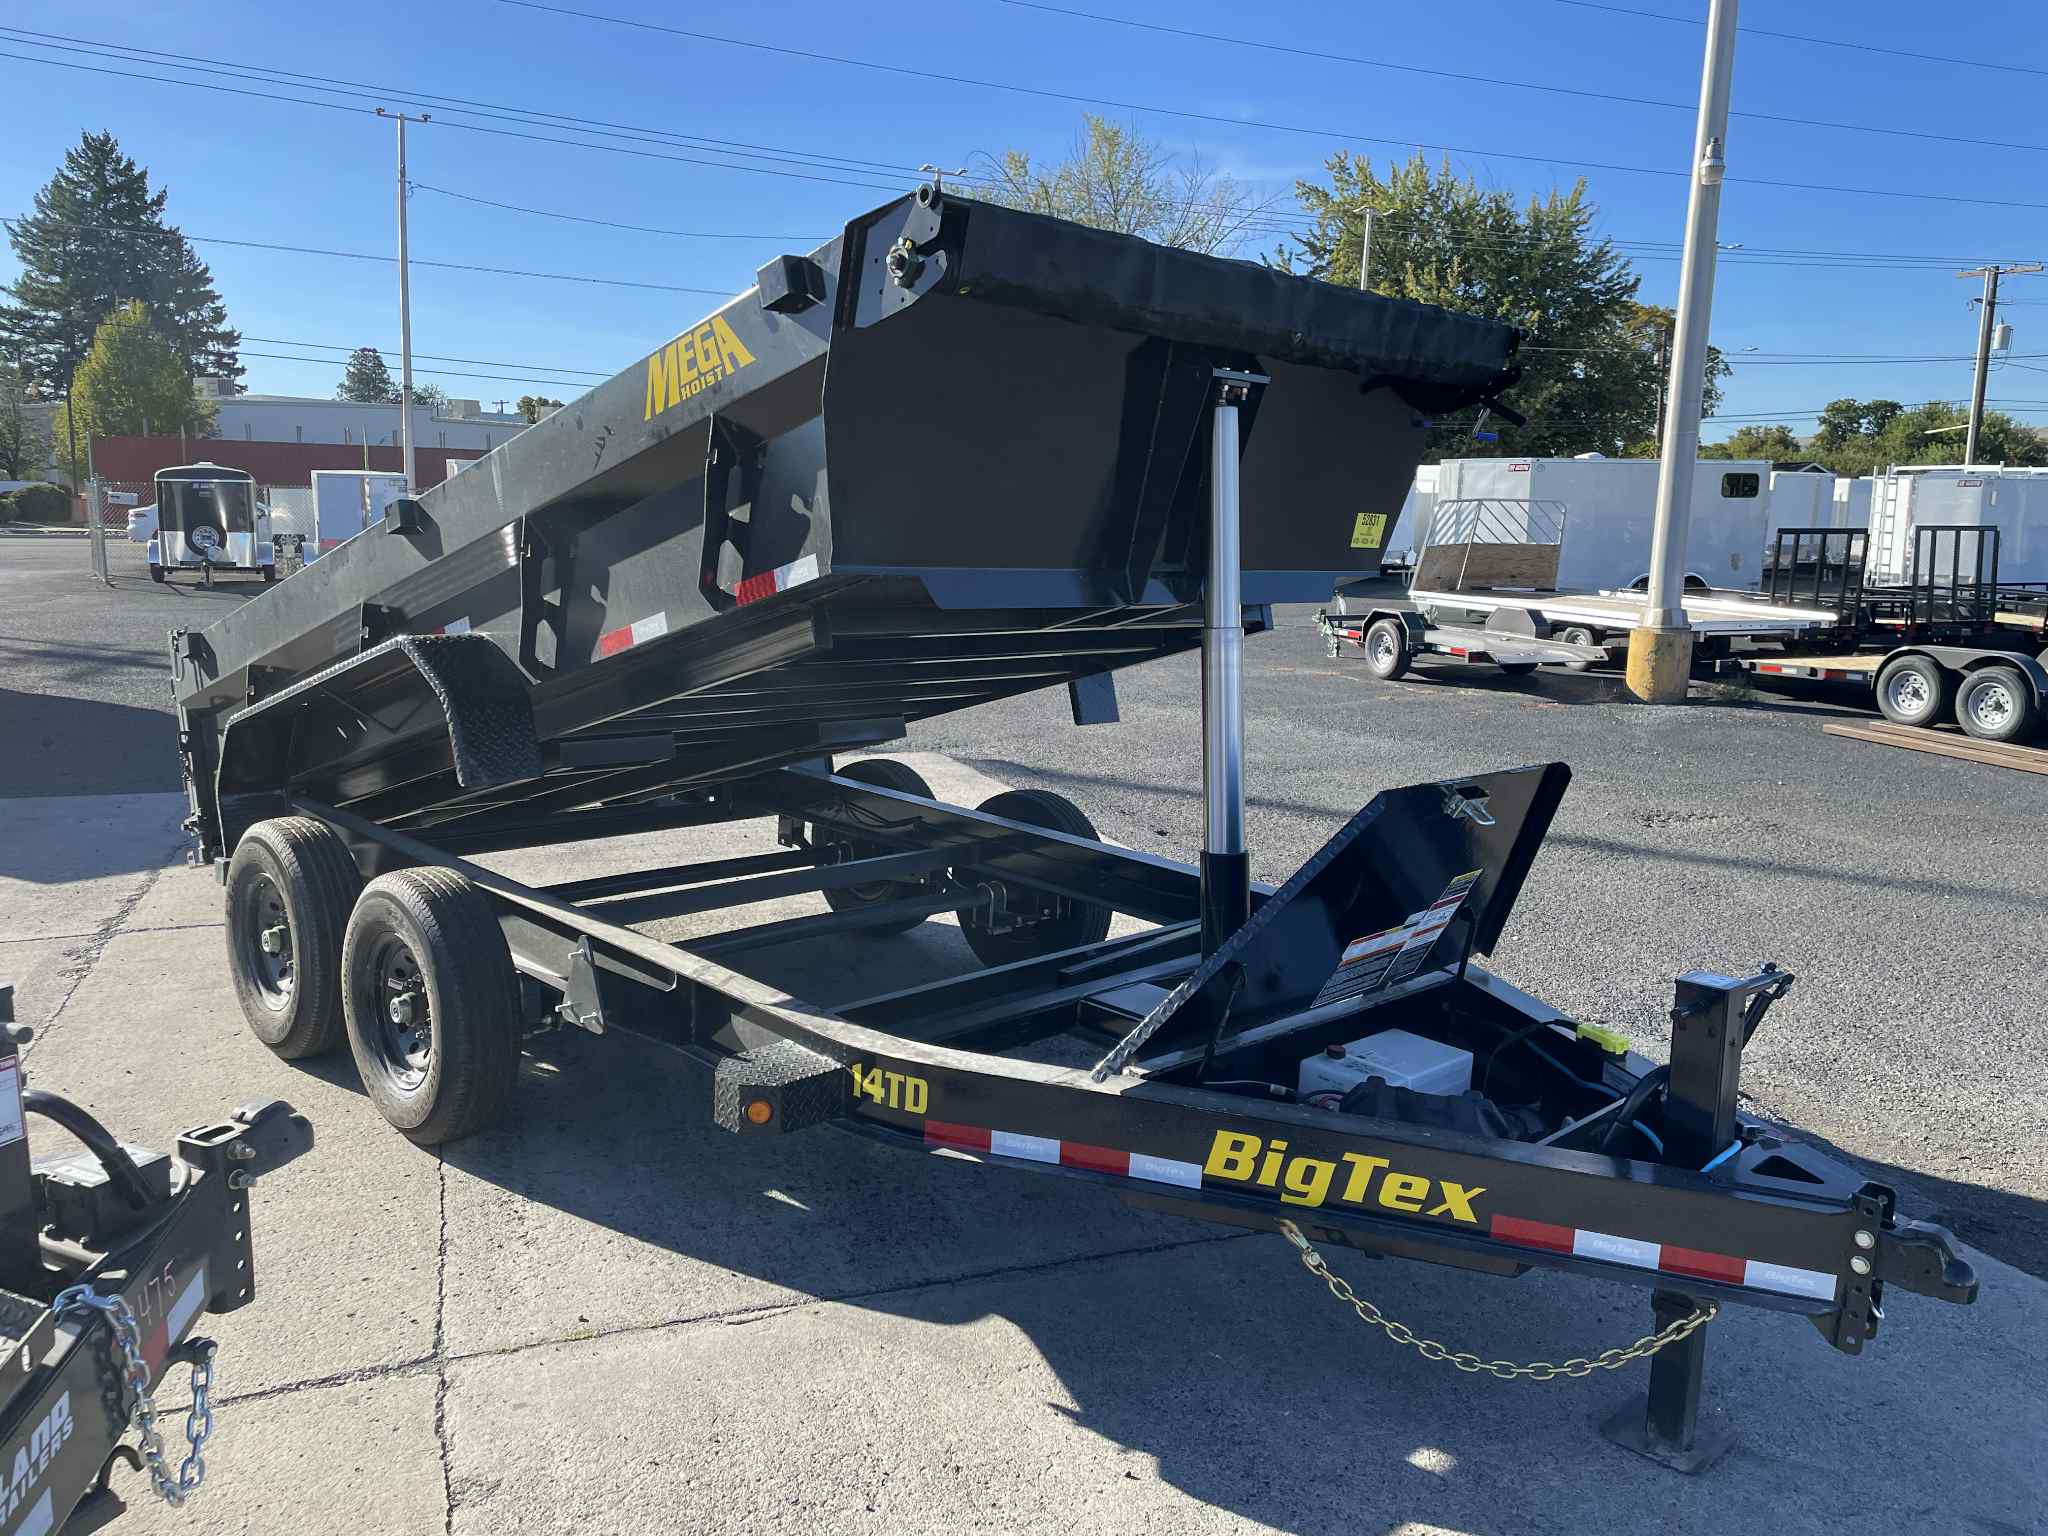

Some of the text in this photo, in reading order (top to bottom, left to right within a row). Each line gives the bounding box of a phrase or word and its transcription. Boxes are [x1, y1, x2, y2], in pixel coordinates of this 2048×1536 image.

[644, 314, 756, 421] MEGA
[680, 367, 723, 400] HOIST
[852, 1063, 928, 1114] 14TD
[1203, 1129, 1487, 1224] BigTex
